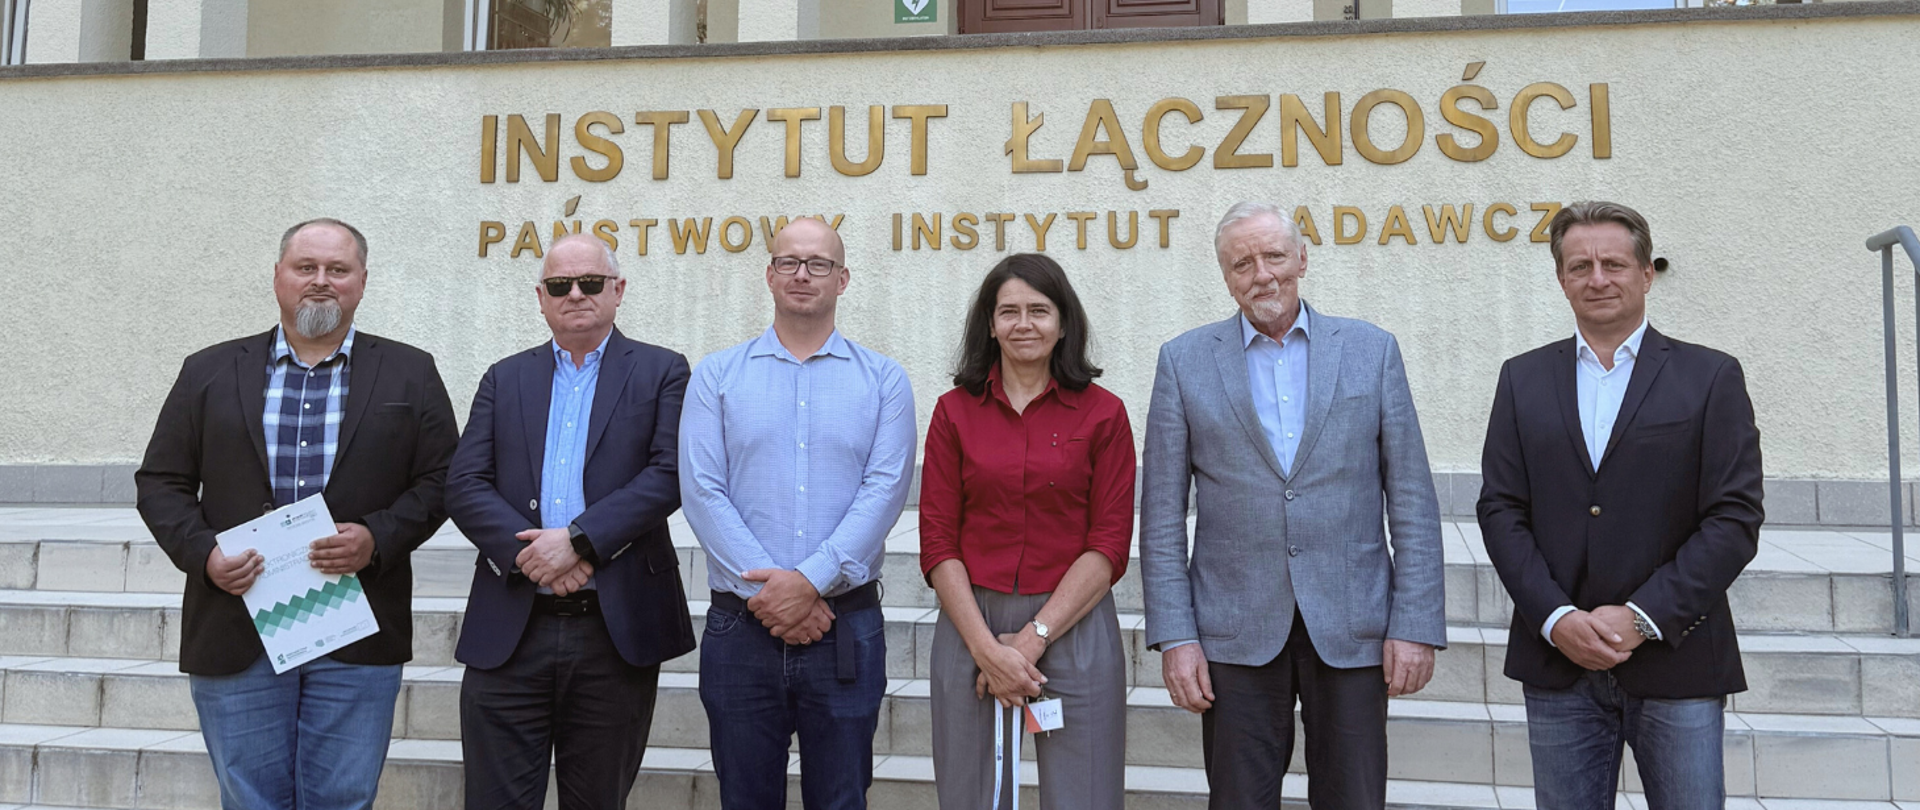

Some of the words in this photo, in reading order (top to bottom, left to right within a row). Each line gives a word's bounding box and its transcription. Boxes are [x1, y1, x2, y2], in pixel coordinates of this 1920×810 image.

[479, 104, 948, 184] INSTYTUT
[1004, 60, 1613, 192] ŁĄCZNOŚCI
[891, 208, 1180, 251] INSTYTUT
[1293, 201, 1563, 246] ADAWCZ
